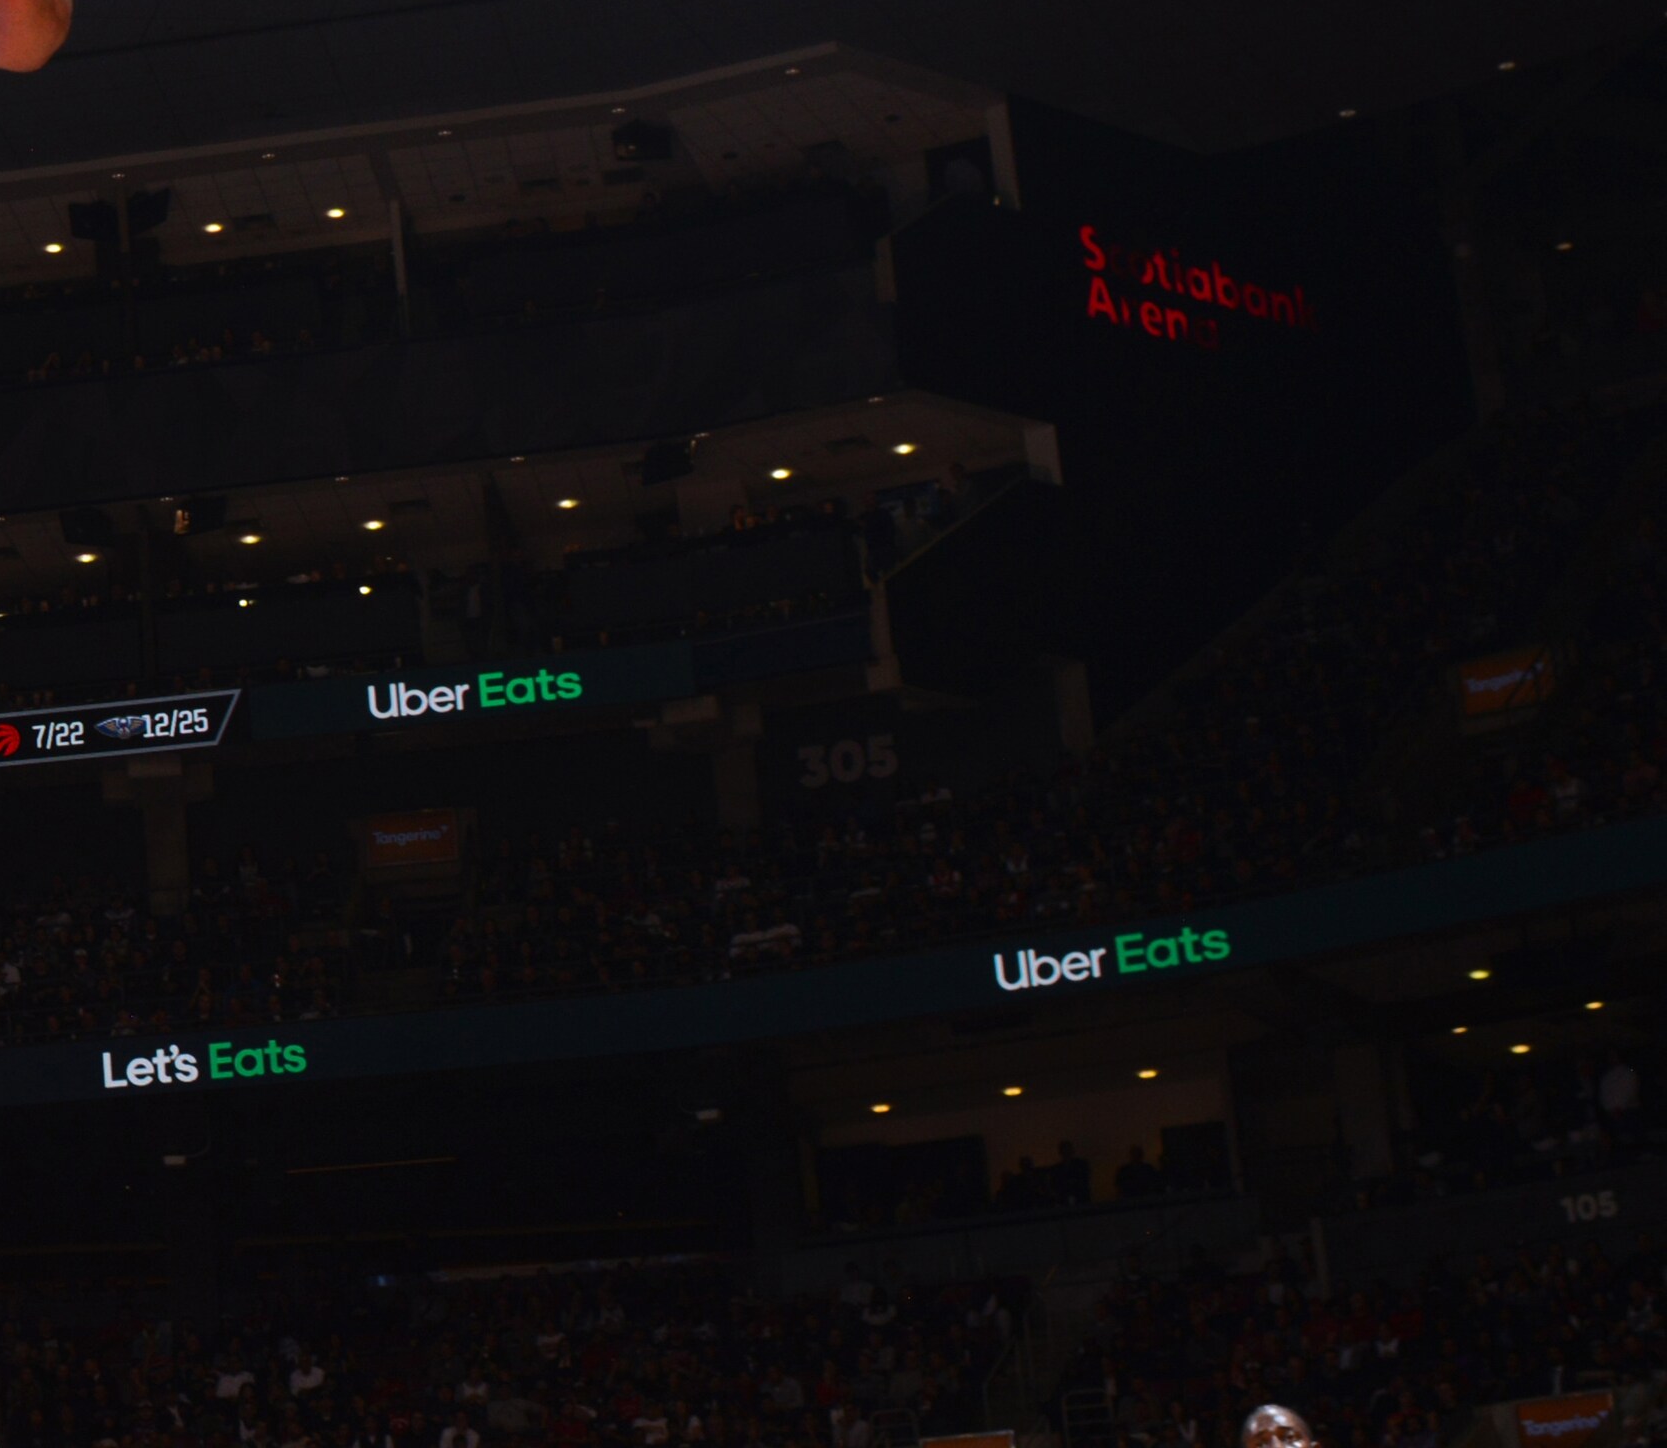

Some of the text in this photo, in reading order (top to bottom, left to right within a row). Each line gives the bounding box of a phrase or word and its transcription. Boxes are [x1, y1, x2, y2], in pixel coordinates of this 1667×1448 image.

[367, 669, 583, 719] Uber Eats
[32, 722, 84, 750] 7/22
[143, 708, 209, 738] 12/25
[798, 734, 898, 788] 305
[994, 927, 1231, 991] Uber Eats
[208, 1039, 307, 1079] Eats
[1560, 1190, 1618, 1224] 105
